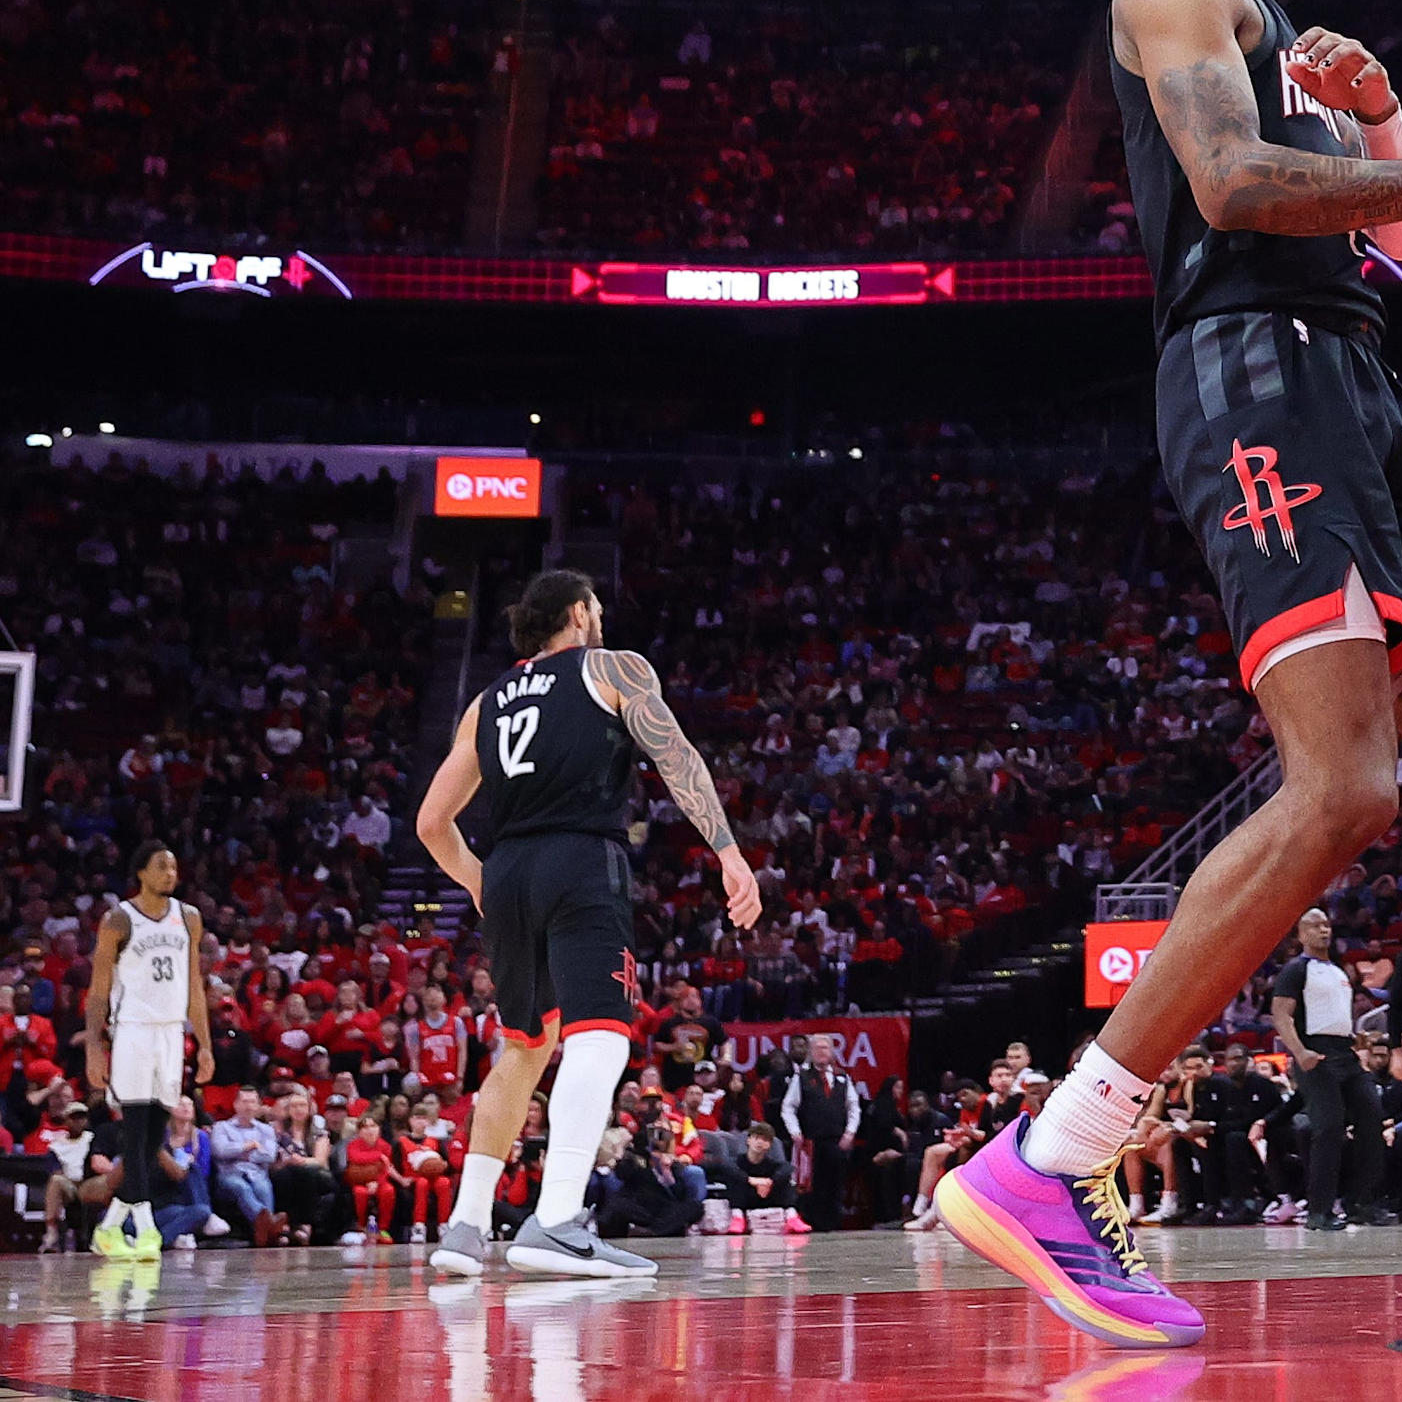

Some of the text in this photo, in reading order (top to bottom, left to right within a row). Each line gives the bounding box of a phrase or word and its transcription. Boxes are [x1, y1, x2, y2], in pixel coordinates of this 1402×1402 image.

[142, 250, 282, 284] LIFTOFF
[666, 269, 860, 301] HOUSTON ROCKETS
[477, 477, 528, 500] PNC
[496, 673, 557, 709] ADAMS
[496, 705, 541, 779] 12
[152, 956, 174, 982] 33
